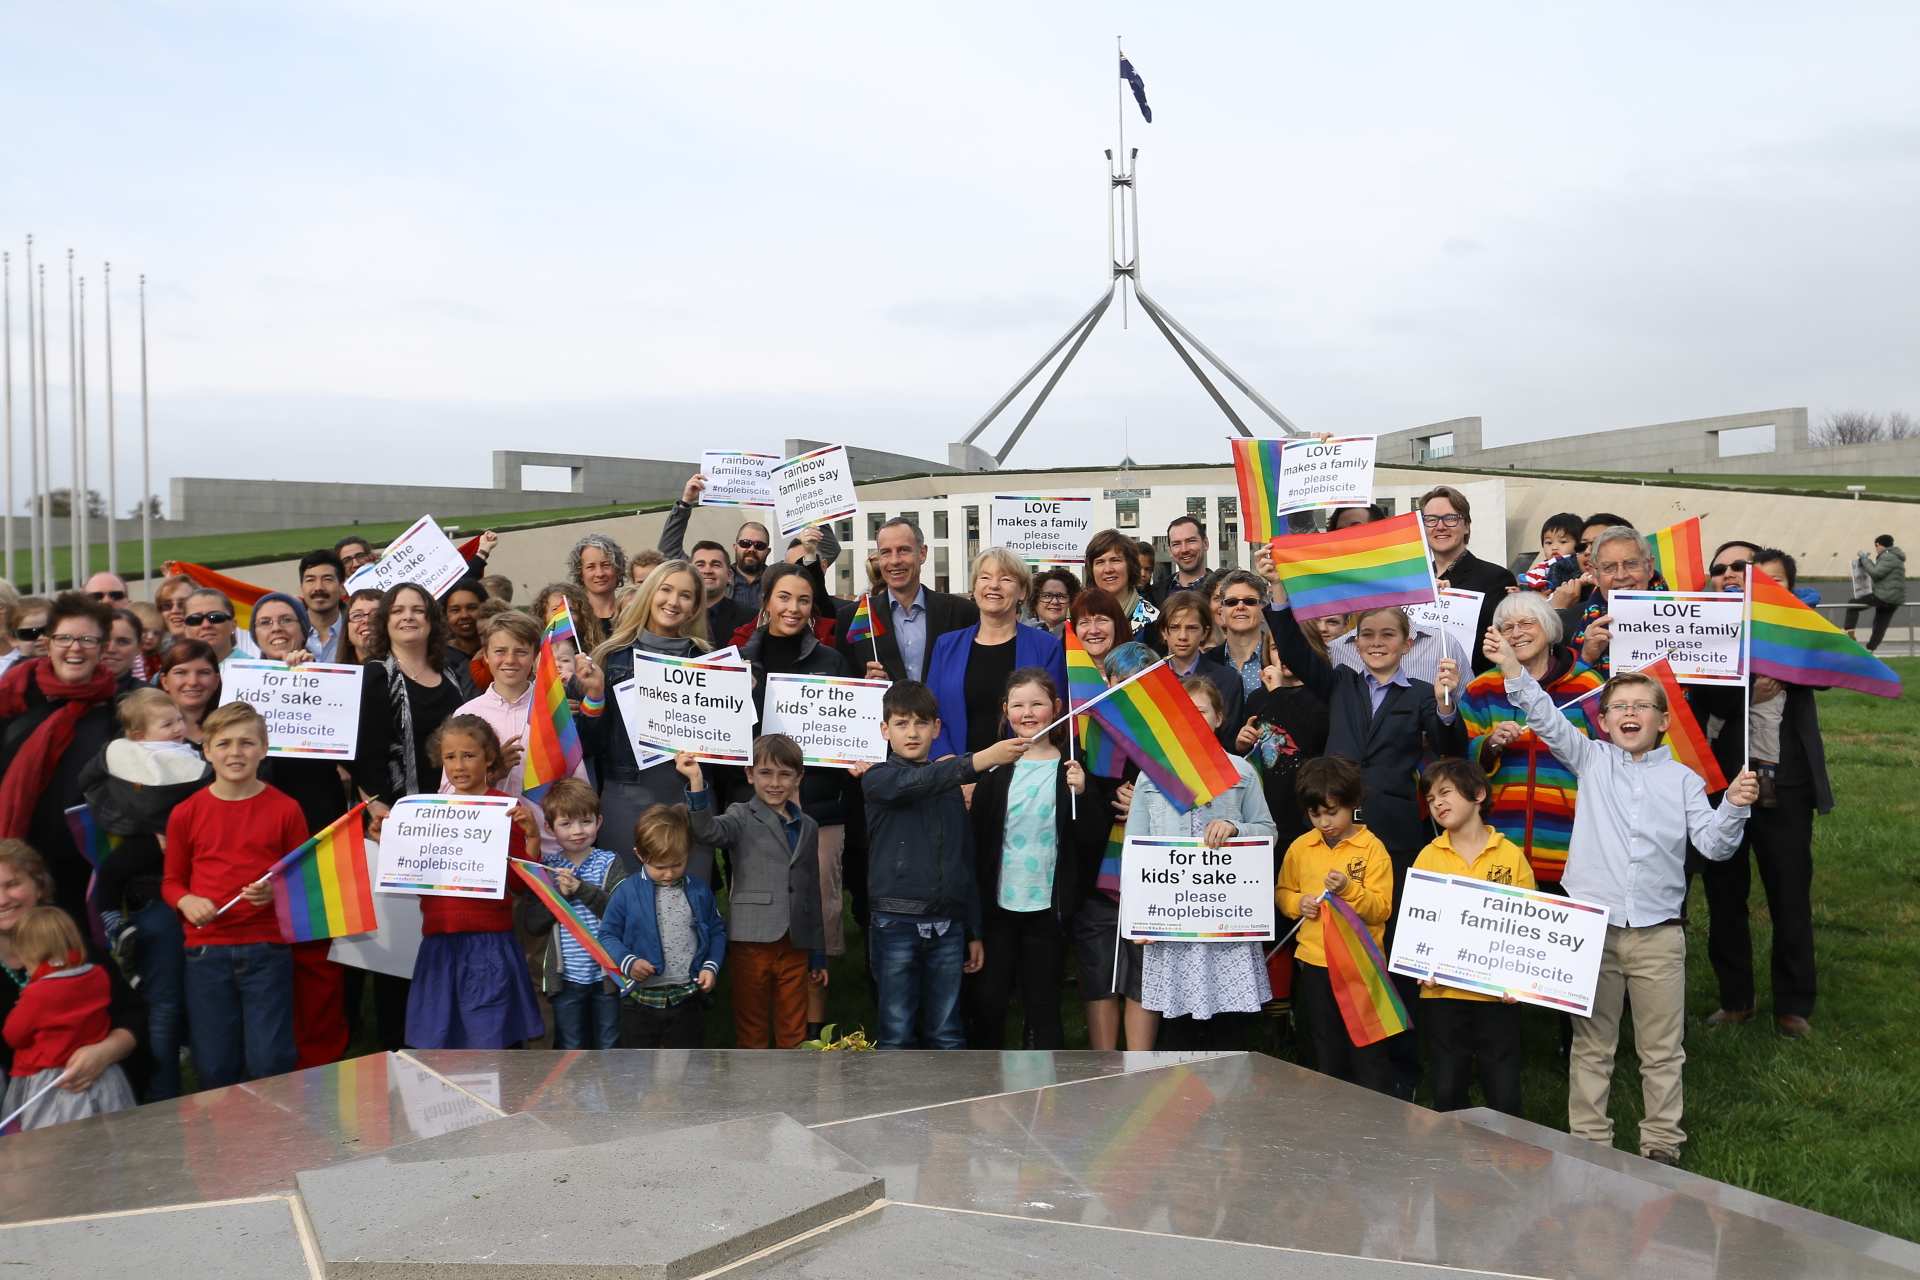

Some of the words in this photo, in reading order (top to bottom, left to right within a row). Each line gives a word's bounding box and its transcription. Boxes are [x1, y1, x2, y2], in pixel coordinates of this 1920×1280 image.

[1307, 446, 1342, 457] LOVE
[722, 457, 764, 466] rainbow
[784, 458, 825, 479] rainbow
[1284, 463, 1316, 476] makes
[1331, 458, 1368, 470] family
[712, 466, 751, 475] families
[755, 469, 771, 479] say
[1304, 474, 1338, 485] please
[779, 476, 816, 496] families
[819, 468, 839, 482] say
[713, 486, 770, 495] #noplebiscite
[795, 488, 823, 503] please
[1289, 483, 1356, 497] #noplebiscite
[786, 492, 843, 518] #noplebiscite
[1025, 503, 1060, 513] LOVE
[997, 517, 1036, 526] makes
[1052, 518, 1087, 530] family
[1025, 531, 1060, 540] please
[1006, 541, 1078, 551] #noplebiscite
[375, 561, 392, 577] for
[392, 544, 414, 561] the
[398, 552, 425, 578] sake
[1654, 604, 1701, 617] LOVE
[1619, 621, 1670, 633] makes
[1675, 625, 1684, 634] a
[1690, 623, 1739, 638] family
[1656, 638, 1702, 649] please
[263, 673, 287, 686] for
[292, 674, 319, 688] the
[664, 668, 706, 687] LOVE
[281, 692, 322, 705] sake
[640, 685, 677, 702] makes
[682, 695, 689, 704] a
[695, 693, 743, 713] family
[801, 685, 824, 698] for
[828, 688, 854, 701] the
[264, 709, 312, 721] please
[665, 708, 706, 724] please
[819, 705, 856, 718] sake
[648, 718, 731, 741] #noplebiscite
[803, 721, 846, 733] please
[416, 806, 480, 820] rainbow
[398, 822, 458, 838] families
[464, 828, 492, 843] say
[420, 843, 463, 856] please
[398, 856, 484, 871] #noplebiscite
[1169, 850, 1196, 865] for
[1202, 851, 1232, 865] the
[1192, 870, 1236, 884] sake
[1175, 890, 1226, 904] please
[1148, 904, 1253, 920] #noplebiscite
[1483, 896, 1568, 924] rainbow
[1461, 910, 1541, 940] families
[1548, 930, 1584, 952] say
[1489, 940, 1547, 961] please
[1457, 948, 1573, 984] #noplebiscite
